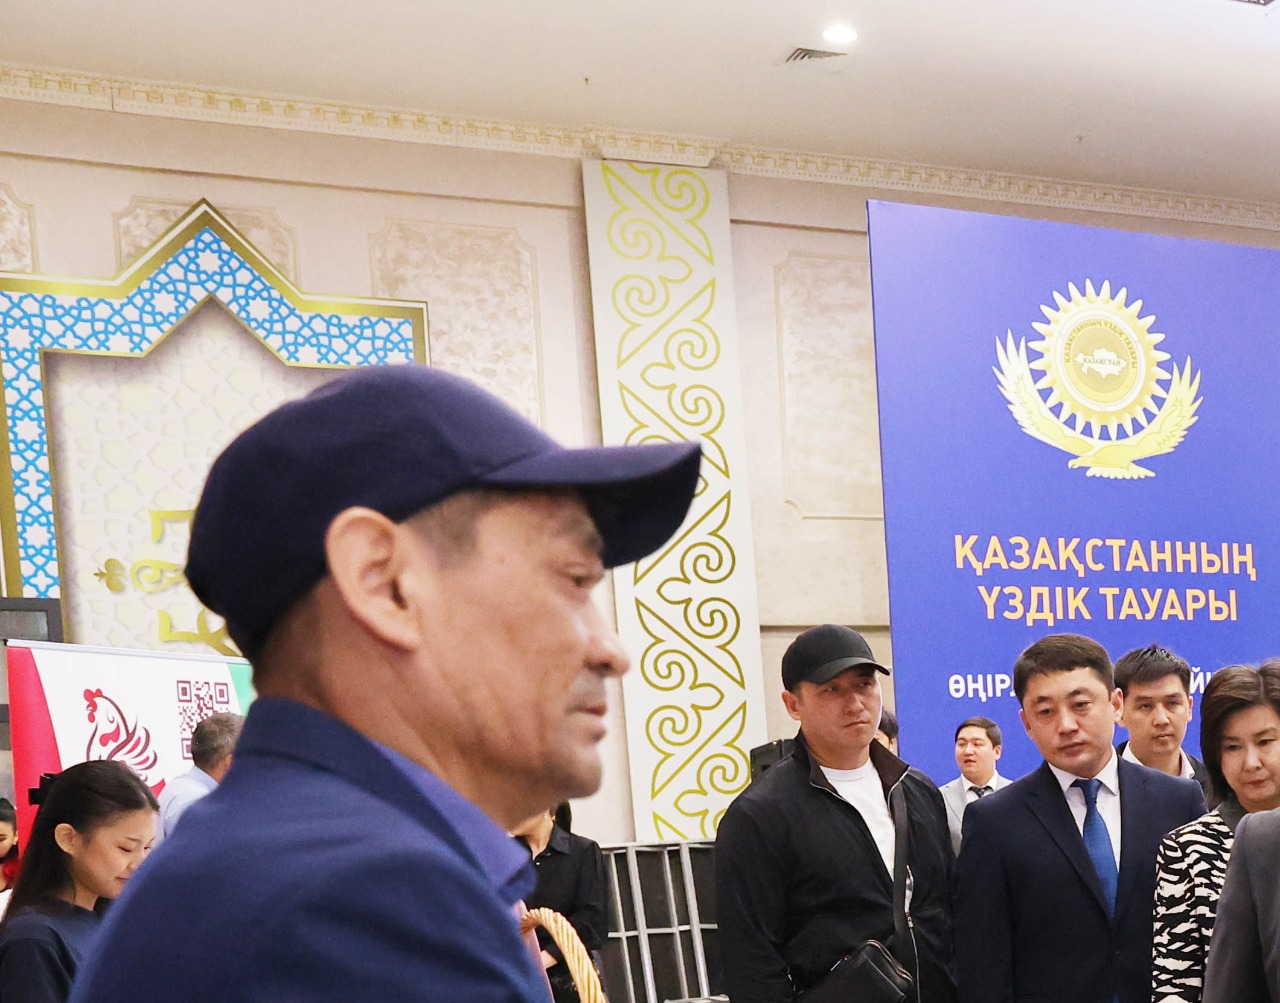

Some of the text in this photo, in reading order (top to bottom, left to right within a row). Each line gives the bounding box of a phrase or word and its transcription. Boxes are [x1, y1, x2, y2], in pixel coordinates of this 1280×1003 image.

[954, 534, 1257, 582] ҚАЗАҚСТАННЫҢ
[977, 585, 1238, 627] ҮЗДІК ТАУАРЫ
[948, 673, 1016, 703] ӨҢІР
